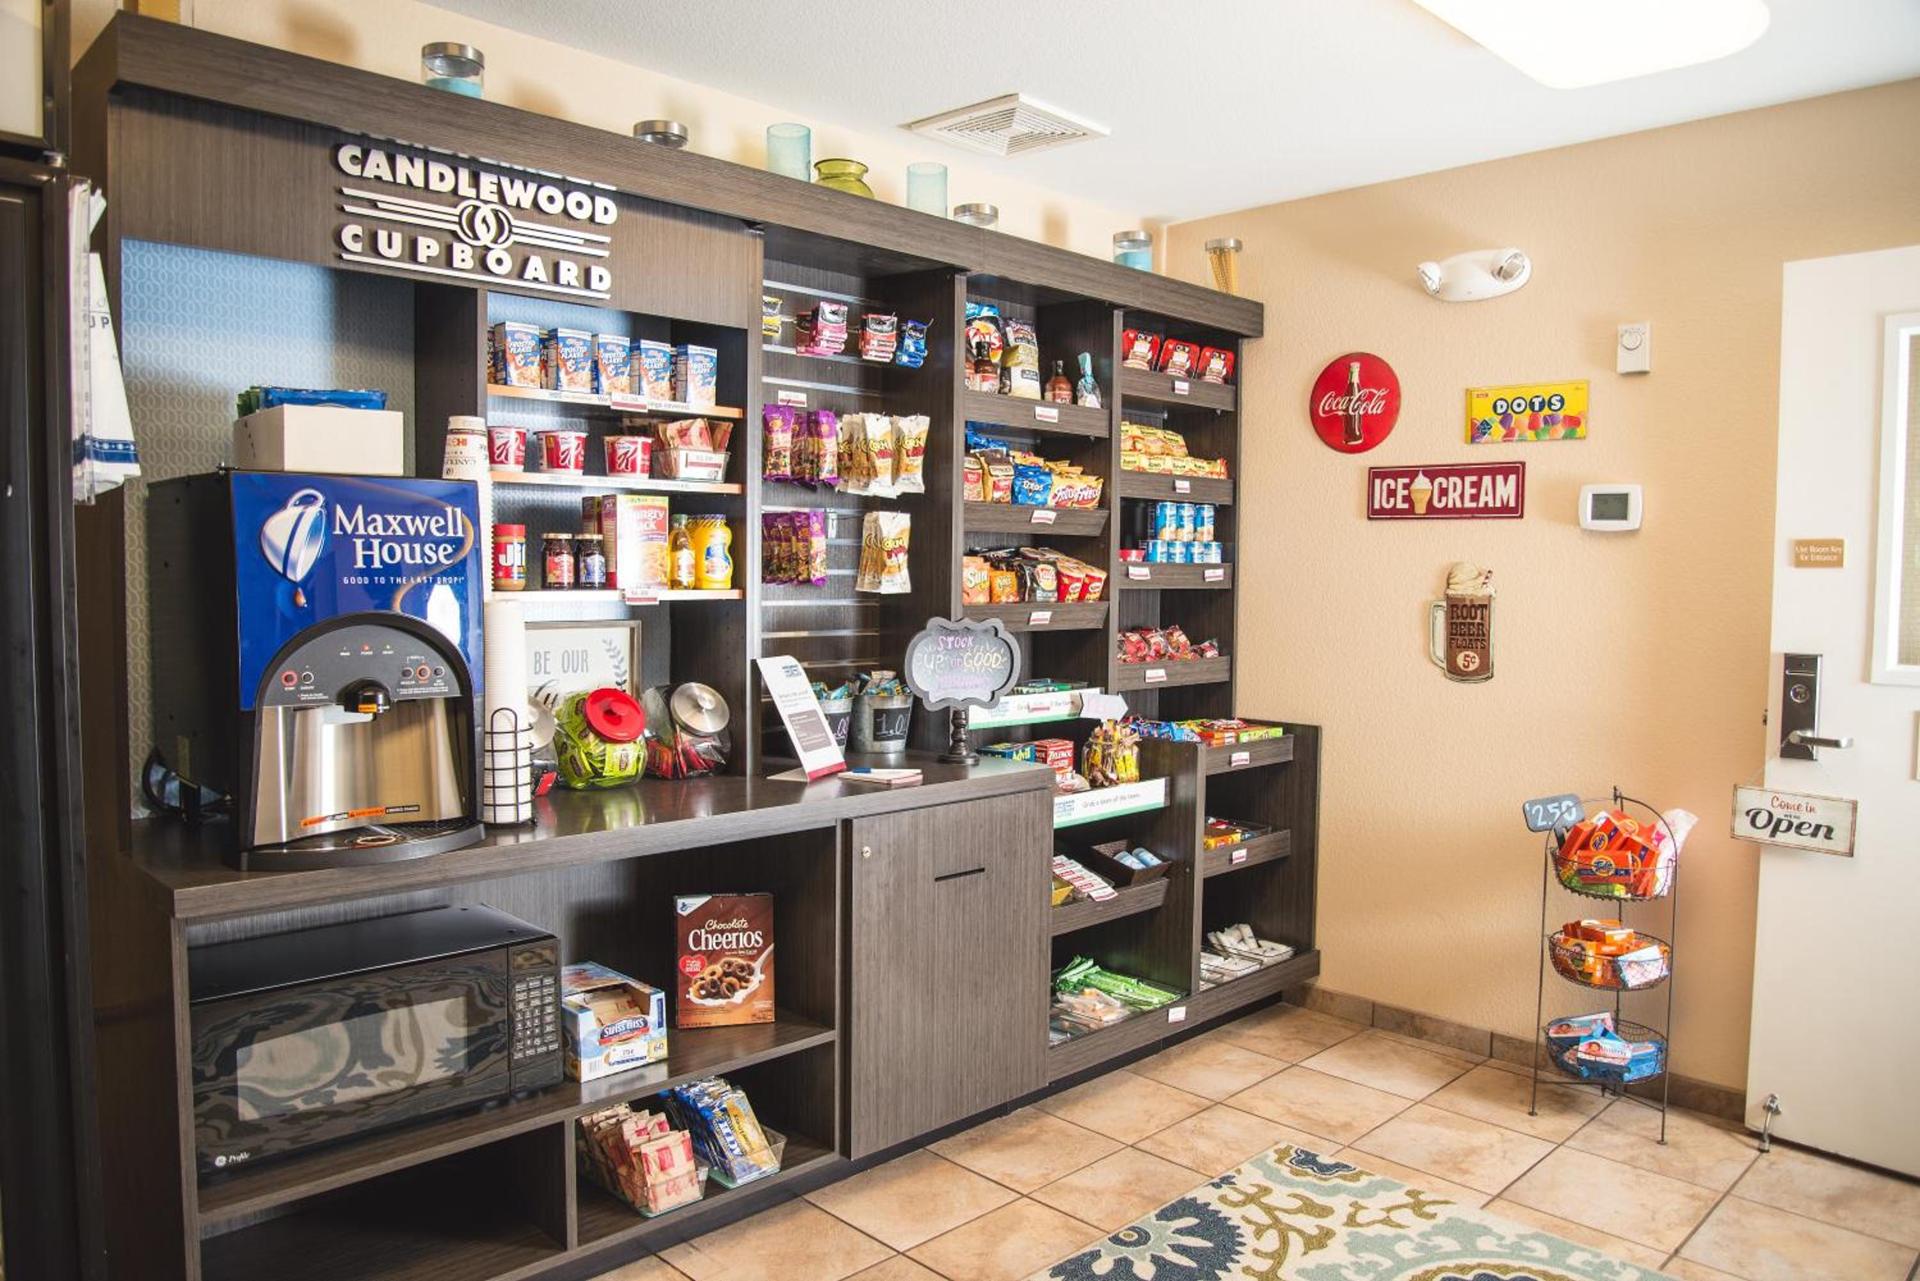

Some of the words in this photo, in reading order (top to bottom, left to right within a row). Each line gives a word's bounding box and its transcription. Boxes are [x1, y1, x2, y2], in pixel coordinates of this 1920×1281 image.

[337, 145, 618, 225] CANDLEWOOD
[340, 224, 612, 291] CUPBOARD
[1319, 388, 1390, 417] Coca-Cola
[1493, 394, 1564, 415] DOTS
[1374, 477, 1409, 509] ICE
[1432, 474, 1516, 508] CREAM
[332, 504, 465, 537] Maxwell
[353, 538, 453, 569] House
[343, 576, 369, 585] GOOD
[374, 576, 386, 584] TO
[390, 576, 407, 584] THE
[411, 576, 433, 584] LAST
[1450, 604, 1488, 620] ROOT
[1450, 622, 1486, 637] BEER
[937, 635, 974, 652] STOCK
[1449, 638, 1486, 649] FLOATS
[534, 650, 551, 675] BE
[561, 649, 589, 674] OUR
[963, 651, 1002, 668] GOOD
[1771, 795, 1802, 812] Come
[1806, 802, 1816, 813] in
[1745, 808, 1835, 840] Open
[705, 918, 749, 930] Chocolate
[688, 928, 763, 951] Cheerios
[603, 1023, 626, 1037] SWISS
